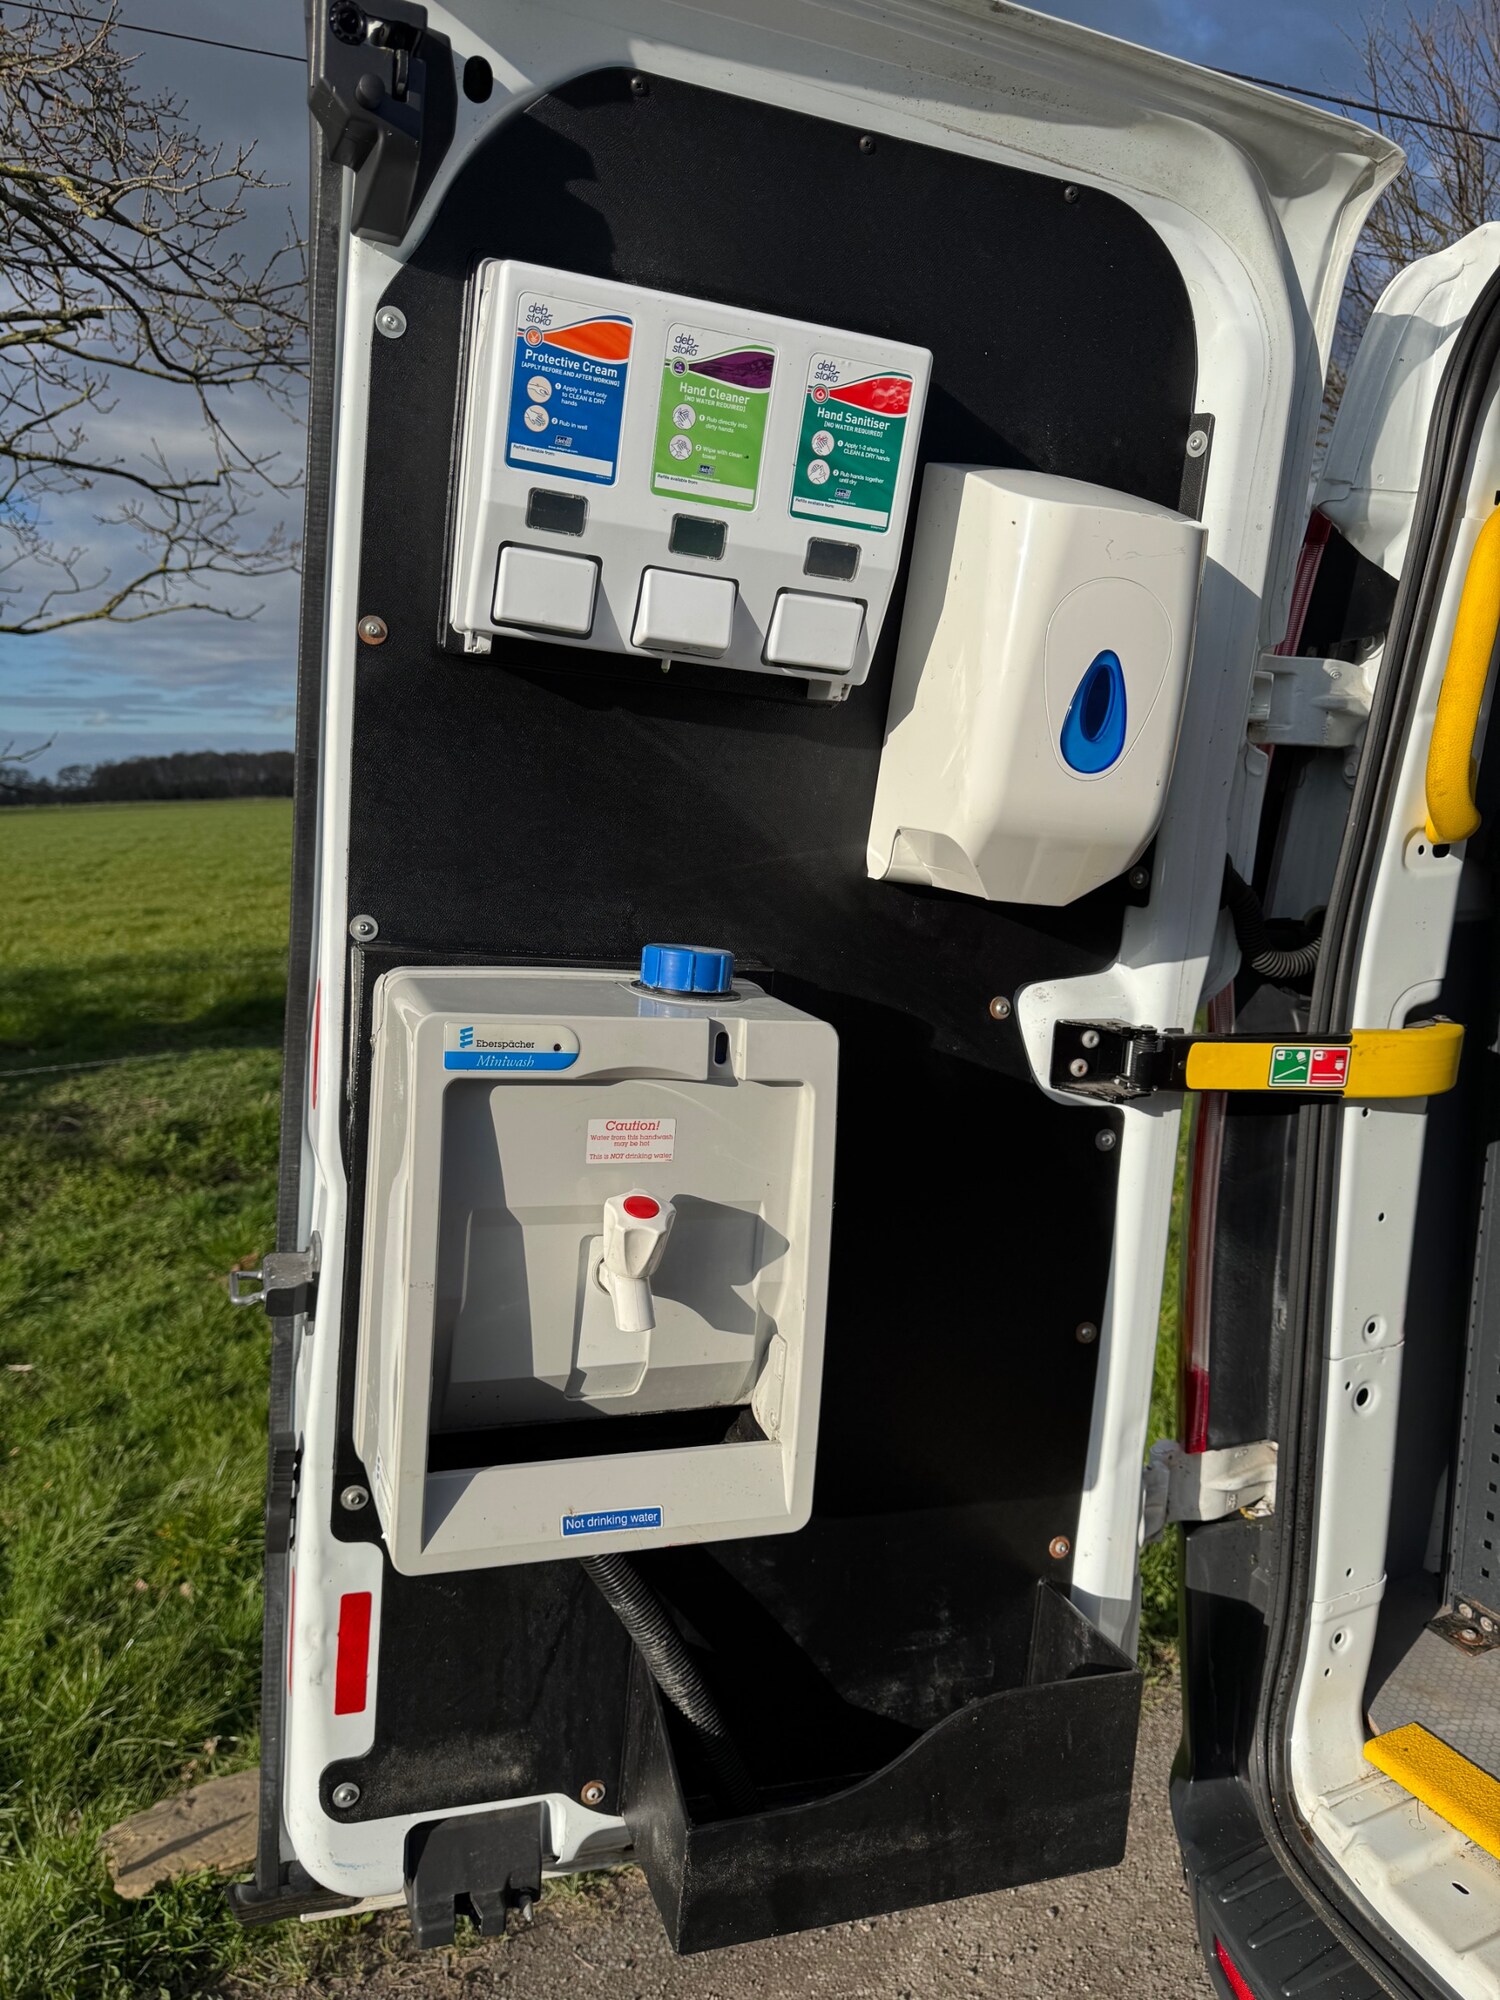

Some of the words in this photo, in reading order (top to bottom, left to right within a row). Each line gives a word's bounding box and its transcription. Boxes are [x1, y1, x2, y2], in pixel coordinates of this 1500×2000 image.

[528, 302, 548, 315] deb
[675, 333, 694, 346] deb
[525, 349, 580, 370] Protective
[582, 361, 618, 378] Cream
[817, 360, 836, 373] deb
[541, 366, 562, 376] BEFORE
[563, 370, 575, 378] AND
[575, 372, 592, 382] AFTER
[562, 384, 578, 394] Apply
[583, 389, 595, 397] shot
[595, 391, 608, 400] only
[680, 382, 706, 396] Hand
[709, 388, 750, 405] Cleaner
[561, 398, 578, 407] hands
[568, 392, 588, 401] CLEAN
[593, 397, 606, 405] DRY
[695, 396, 715, 406] WATER
[559, 419, 570, 428] Rub
[577, 423, 588, 431] well
[706, 416, 718, 424] Rub
[718, 418, 737, 428] directly
[817, 407, 844, 422] Hand
[845, 412, 891, 431] Sanitiser
[705, 423, 718, 432] dirty
[718, 425, 734, 433] hands
[834, 422, 854, 432] WATER
[702, 446, 716, 454] Wipe
[728, 450, 743, 458] clean
[844, 442, 859, 450] Apply
[866, 445, 880, 453] shots
[843, 448, 861, 457] CLEAN
[865, 452, 876, 460] DRY
[876, 454, 890, 462] hands
[839, 470, 850, 478] Rub
[850, 472, 865, 481] hands
[865, 475, 885, 484] together
[476, 1040, 535, 1049] Eberspächer
[476, 1055, 535, 1067] Miniwash
[605, 1120, 661, 1131] Caution!
[625, 1152, 652, 1160] drinking
[566, 1519, 584, 1530] Not
[587, 1514, 628, 1526] drinking
[630, 1512, 658, 1523] water
